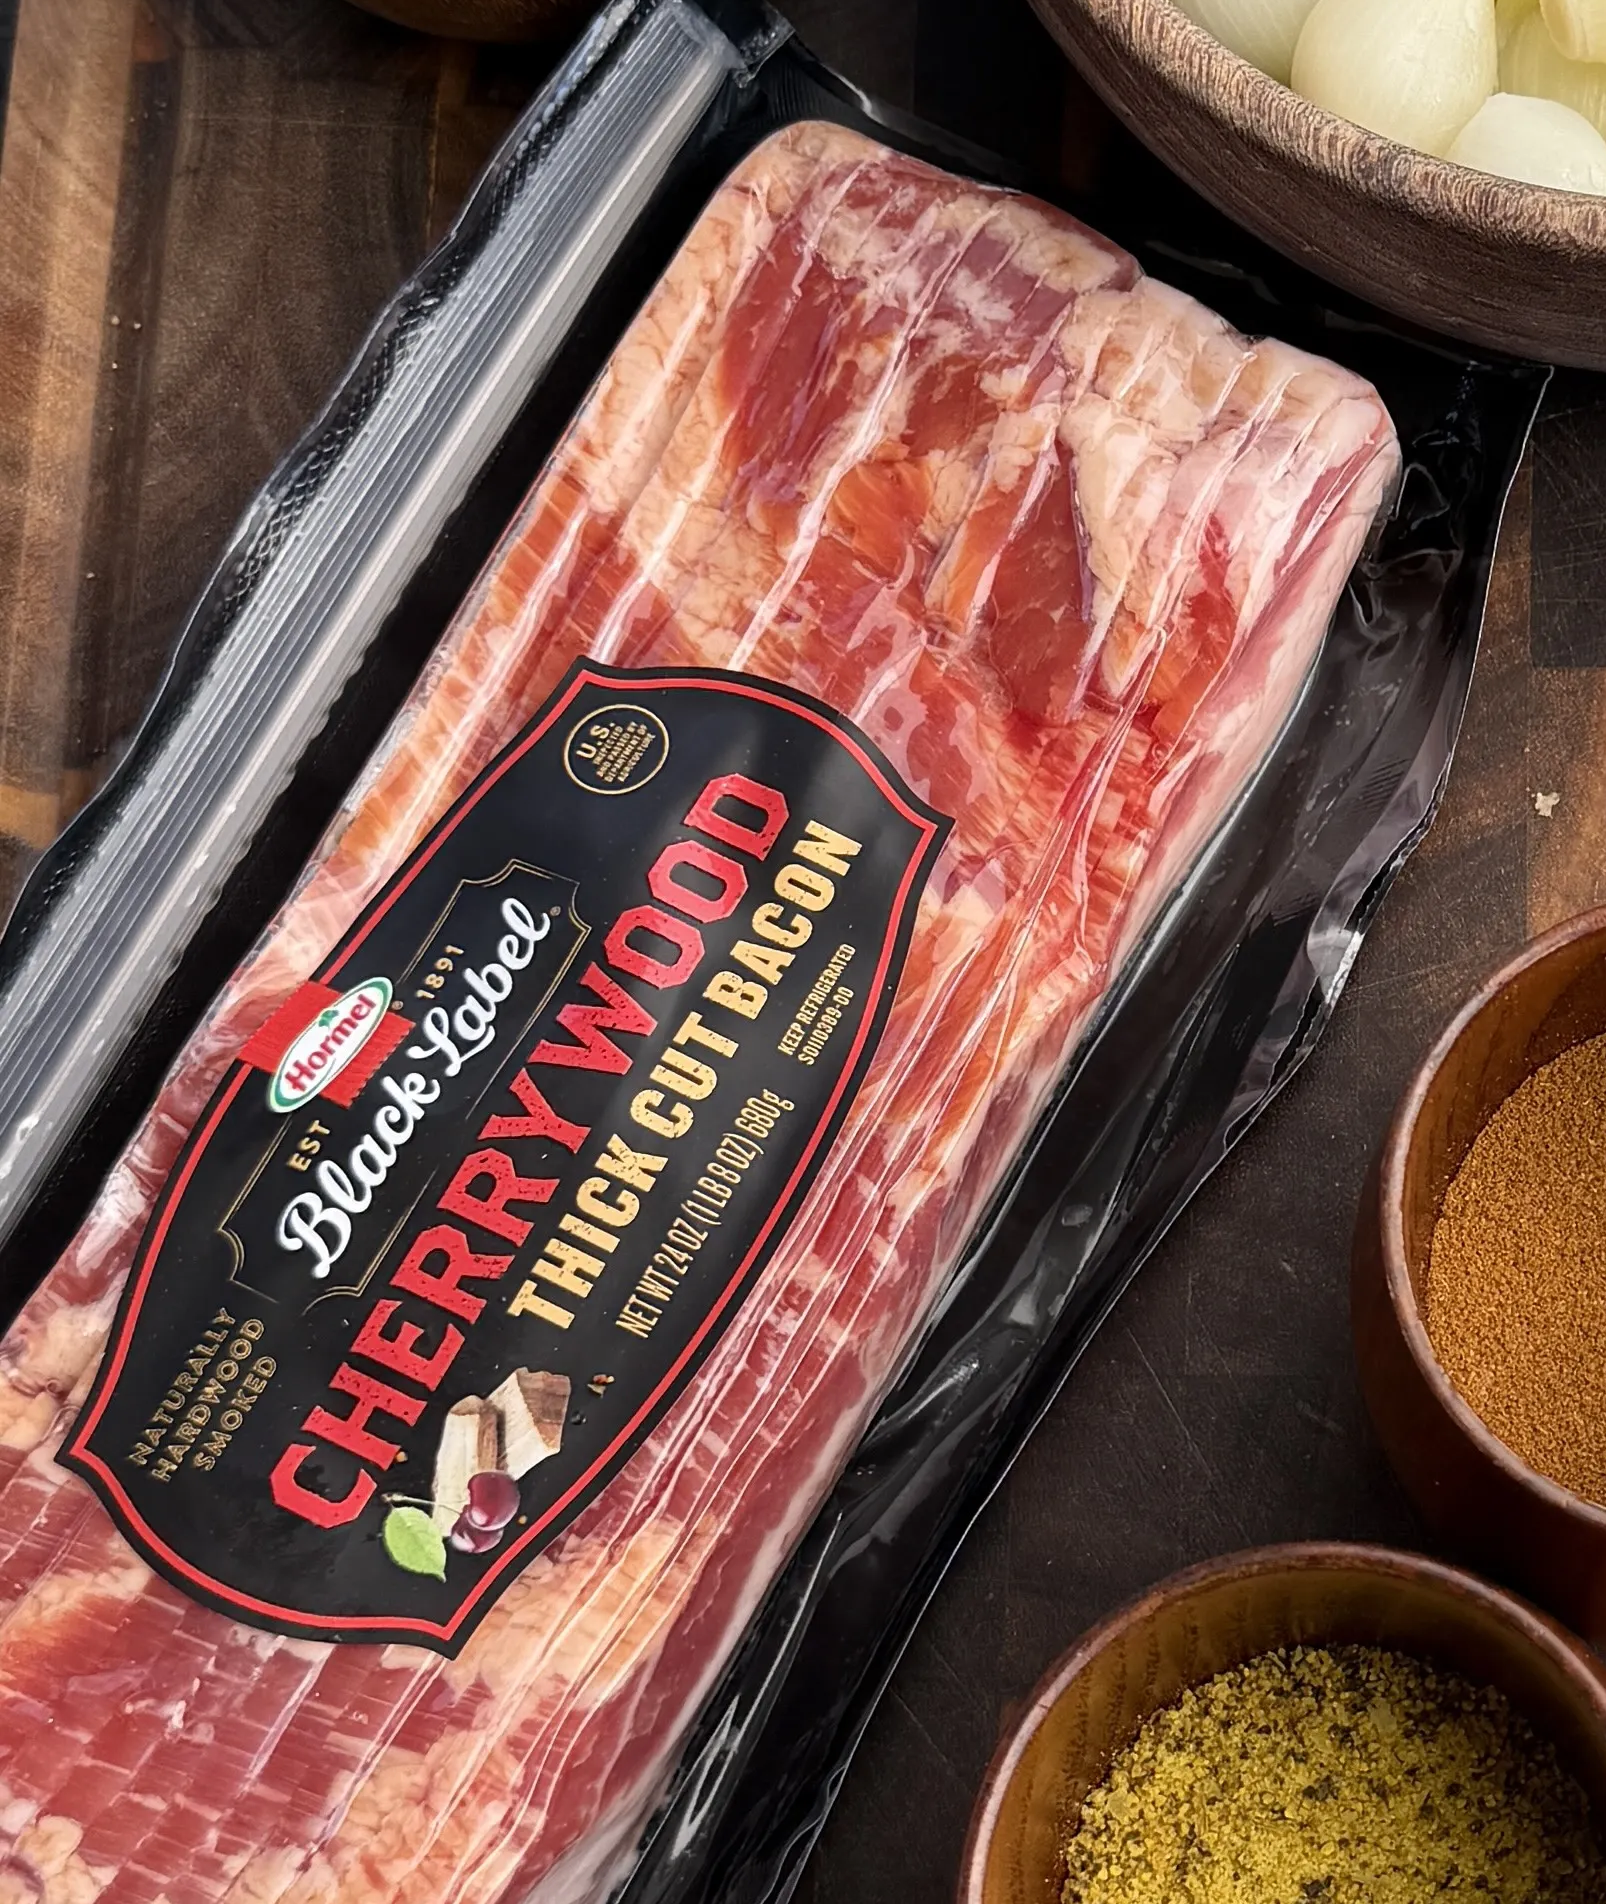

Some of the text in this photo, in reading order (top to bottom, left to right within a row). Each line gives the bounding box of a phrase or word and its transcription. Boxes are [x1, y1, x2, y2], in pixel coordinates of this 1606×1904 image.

[576, 722, 615, 759] U.S.
[777, 943, 857, 1056] KEEP REFRIGERATED
[283, 993, 378, 1093] Hormel
[288, 943, 465, 1173] EST 1891
[506, 819, 863, 1330] THICK CUT BACON
[274, 897, 552, 1280] Black Label
[734, 1088, 796, 1140] 680g
[268, 772, 792, 1530] CHERRYWOOD
[706, 1162, 742, 1185] 8
[715, 1132, 765, 1170] OZ)
[692, 1176, 733, 1210] LB
[653, 1243, 694, 1276] 24
[667, 1217, 709, 1251] OZ
[615, 1293, 663, 1339] NET
[635, 1264, 680, 1302] WT
[127, 1307, 236, 1465] NATURALLY
[151, 1318, 265, 1482] HARDWOOD
[193, 1356, 277, 1472] SMOKED
